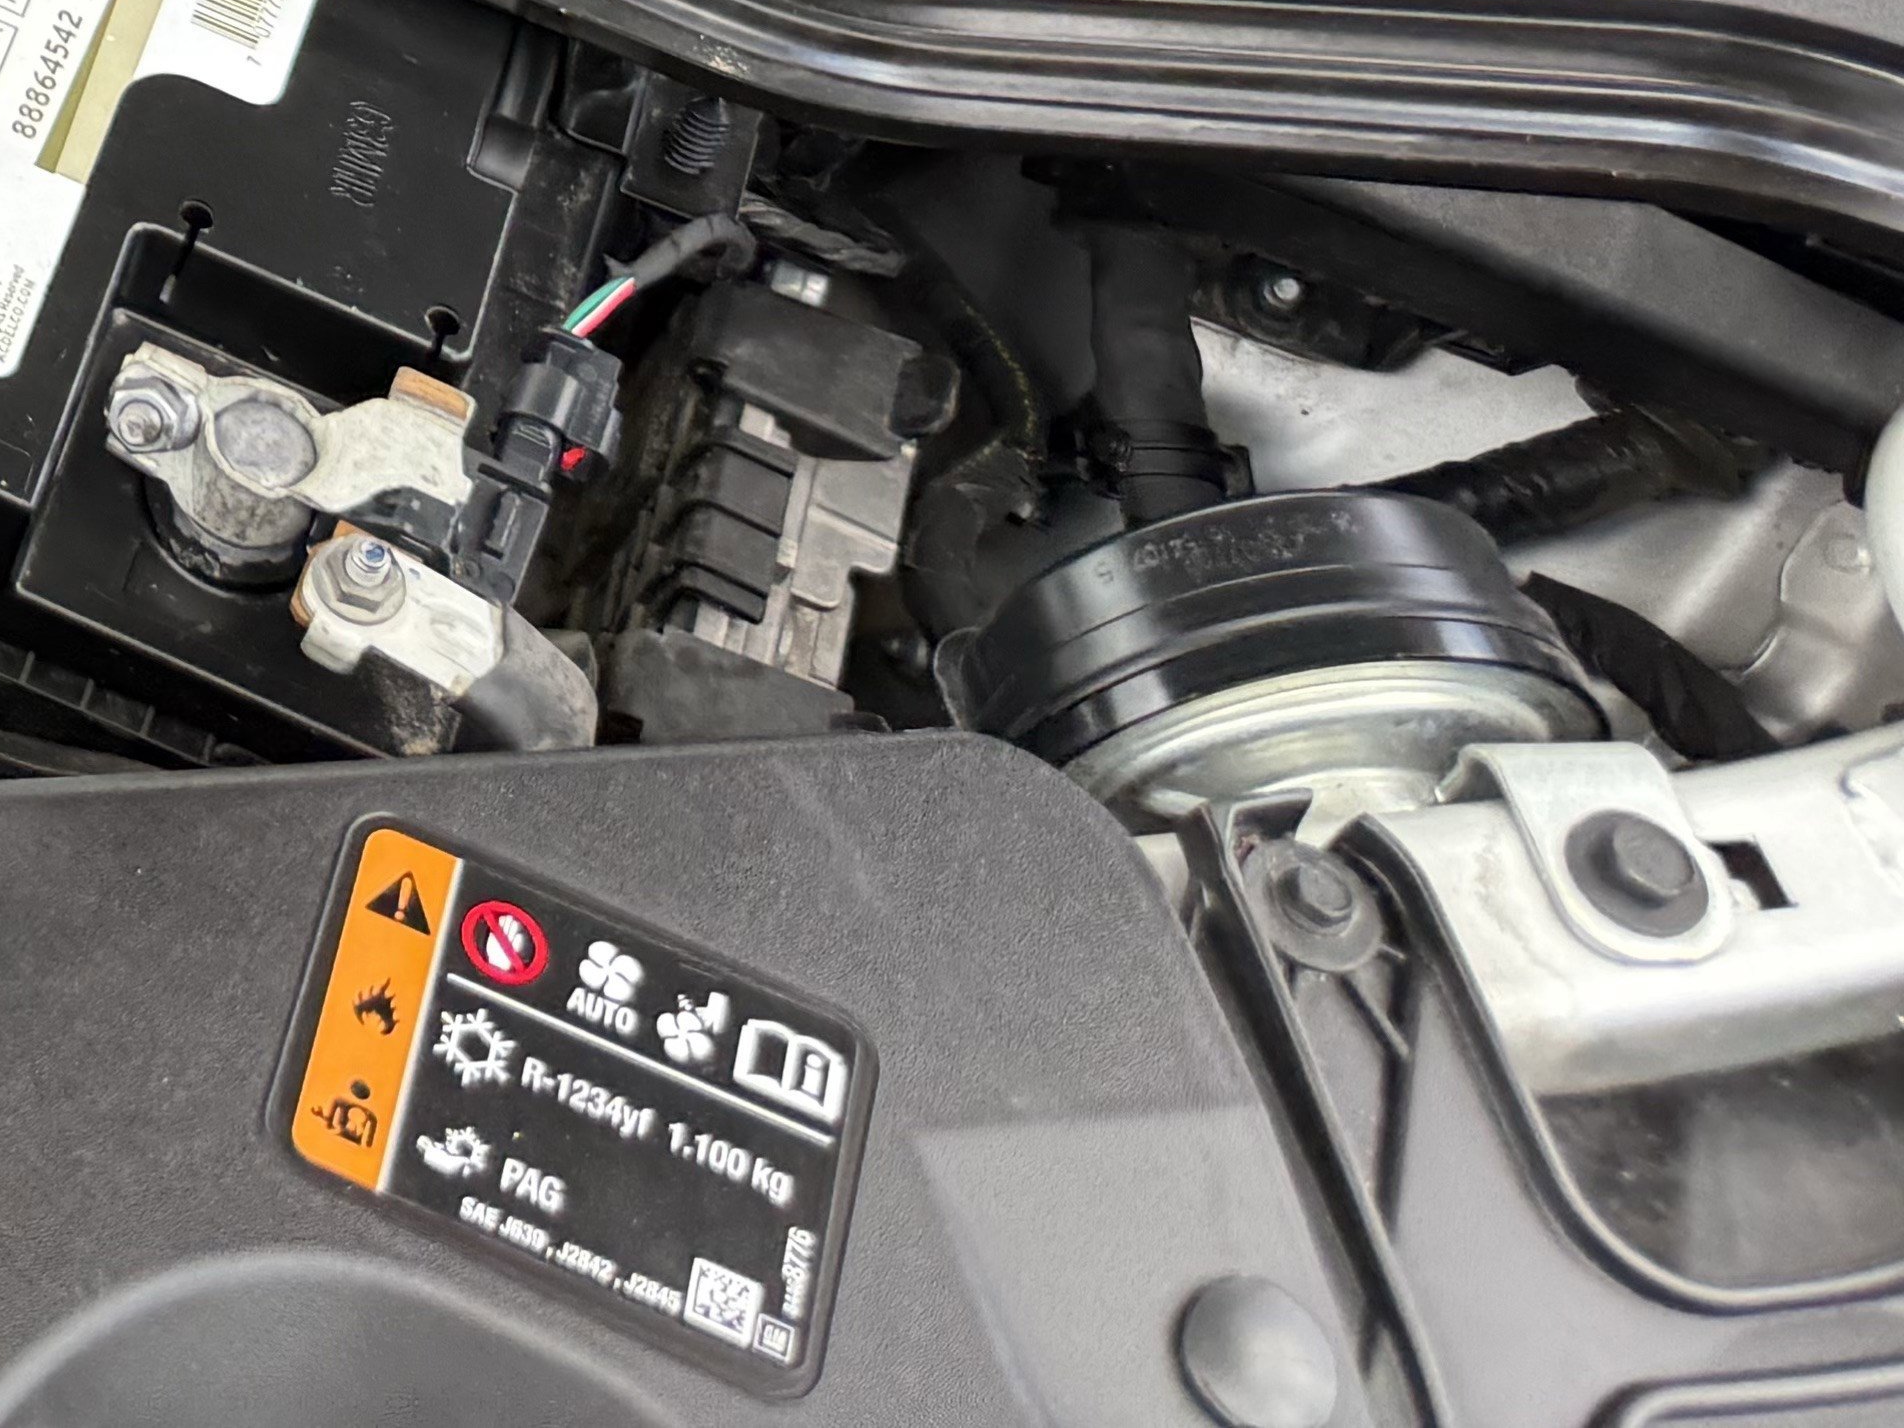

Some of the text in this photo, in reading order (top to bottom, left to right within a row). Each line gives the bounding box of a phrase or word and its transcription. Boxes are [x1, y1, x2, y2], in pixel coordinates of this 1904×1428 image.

[8, 6, 85, 141] 88864542
[567, 990, 636, 1034] AUTO
[520, 1058, 796, 1208] R-1234yf 1.100 kg
[500, 1158, 567, 1211] PAG
[460, 1196, 498, 1230] SAE
